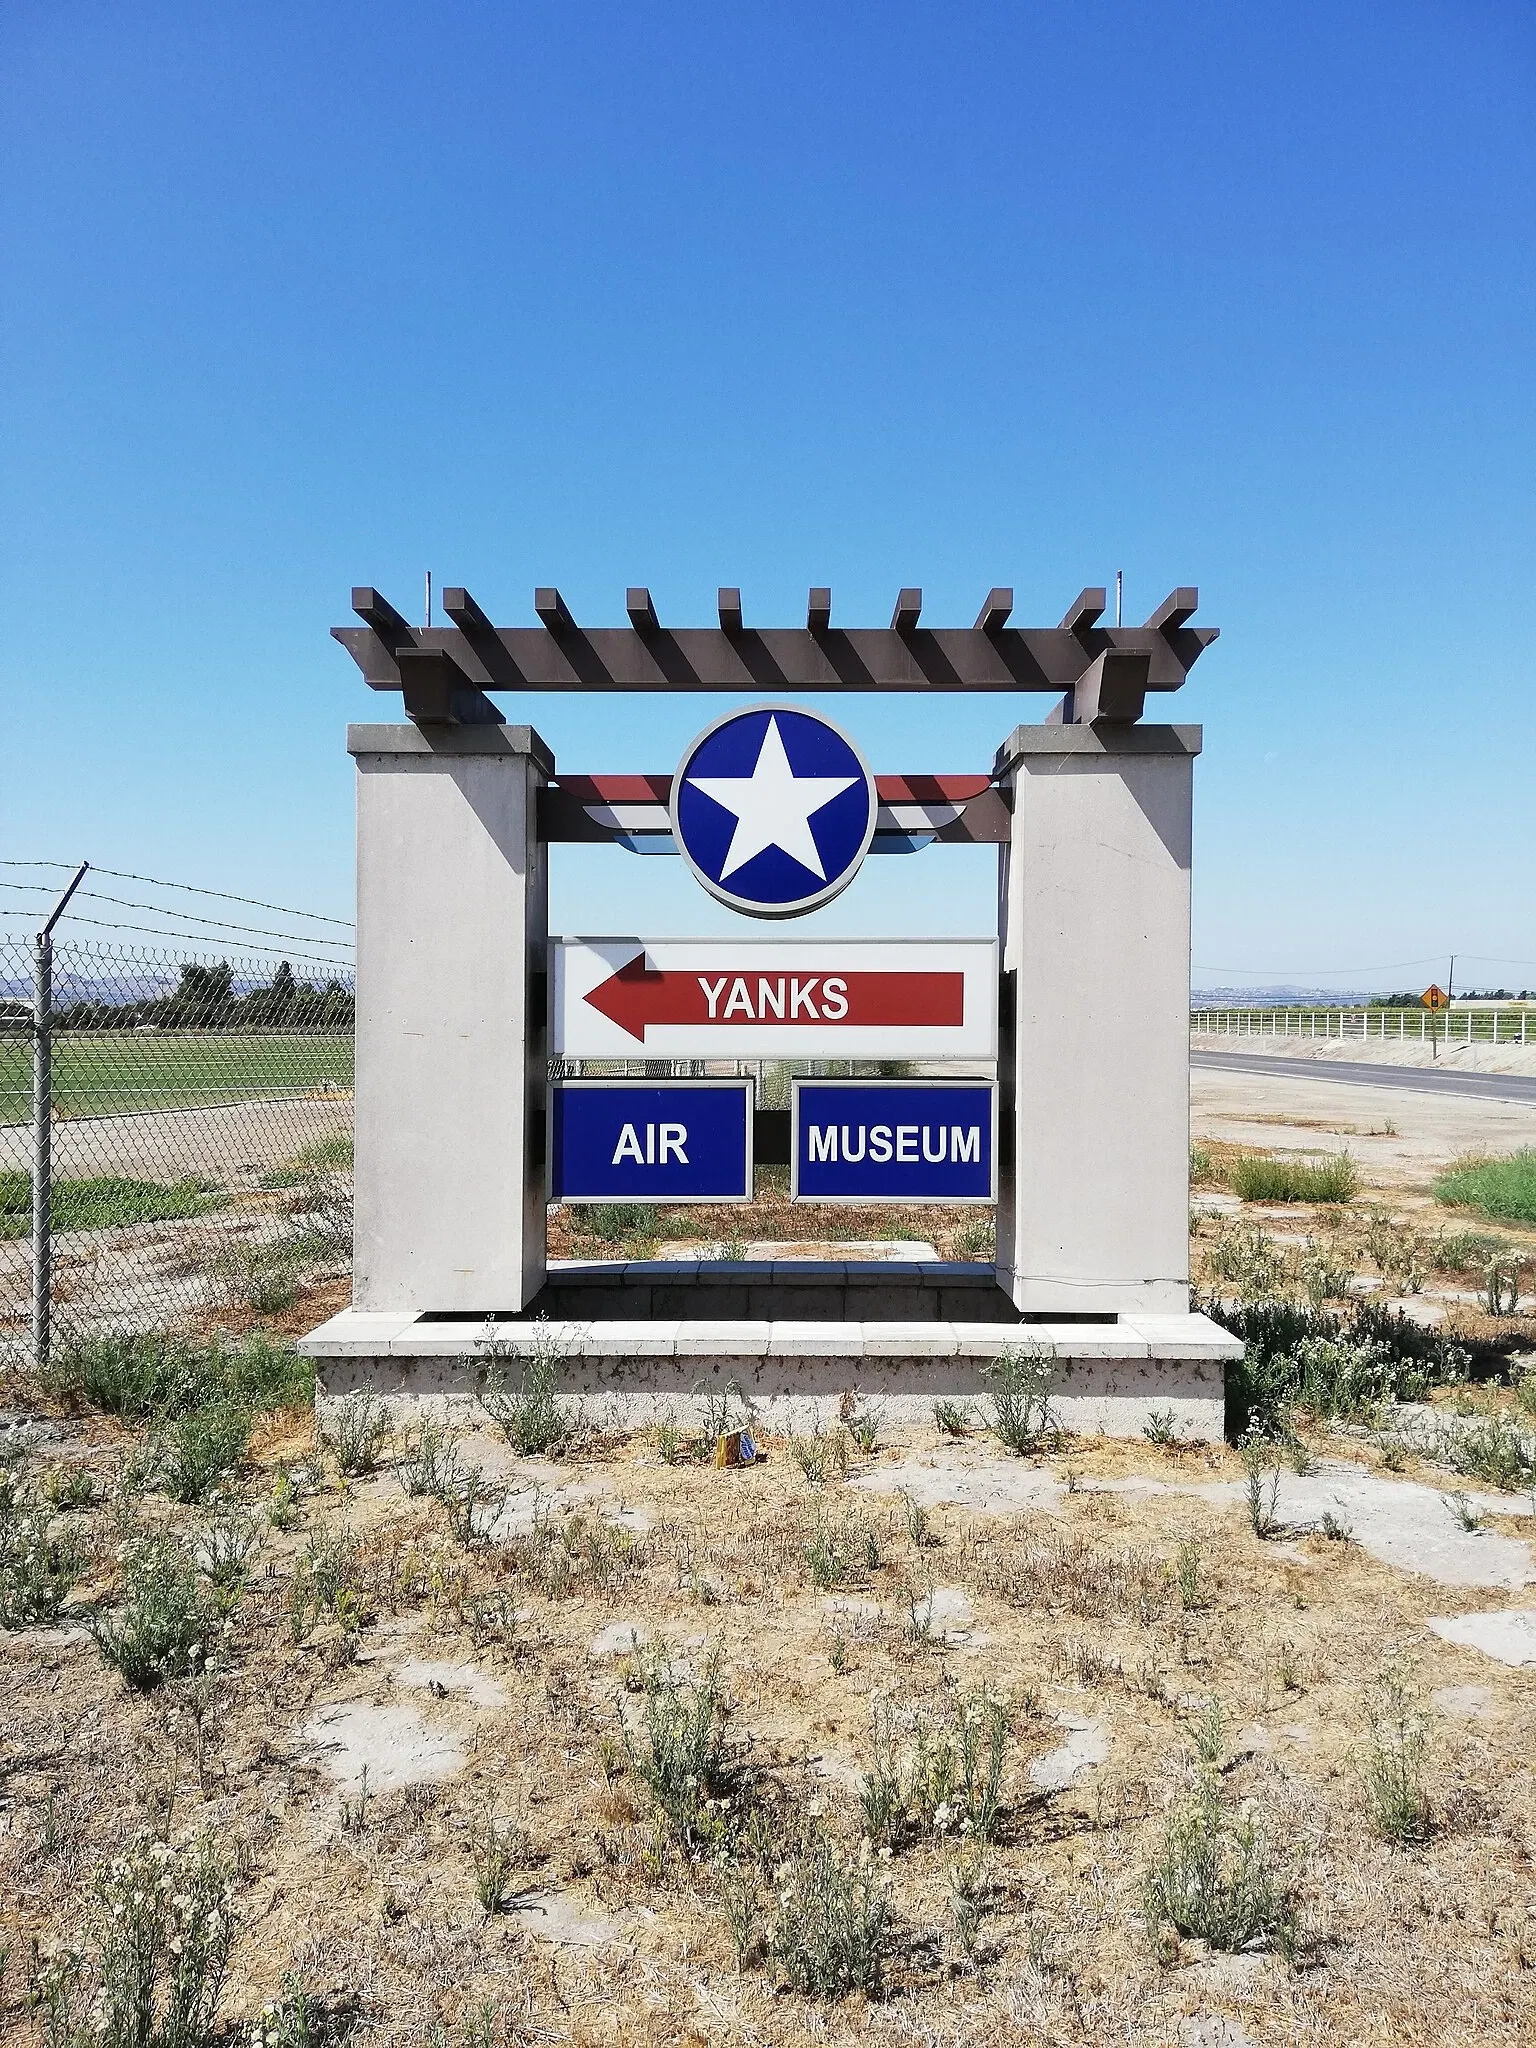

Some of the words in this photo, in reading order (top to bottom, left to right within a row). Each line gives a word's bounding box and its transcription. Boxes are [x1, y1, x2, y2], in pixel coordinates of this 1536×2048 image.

[697, 977, 849, 1020] YANKS
[611, 1123, 690, 1165] AIR
[808, 1125, 980, 1163] MUSEUM
